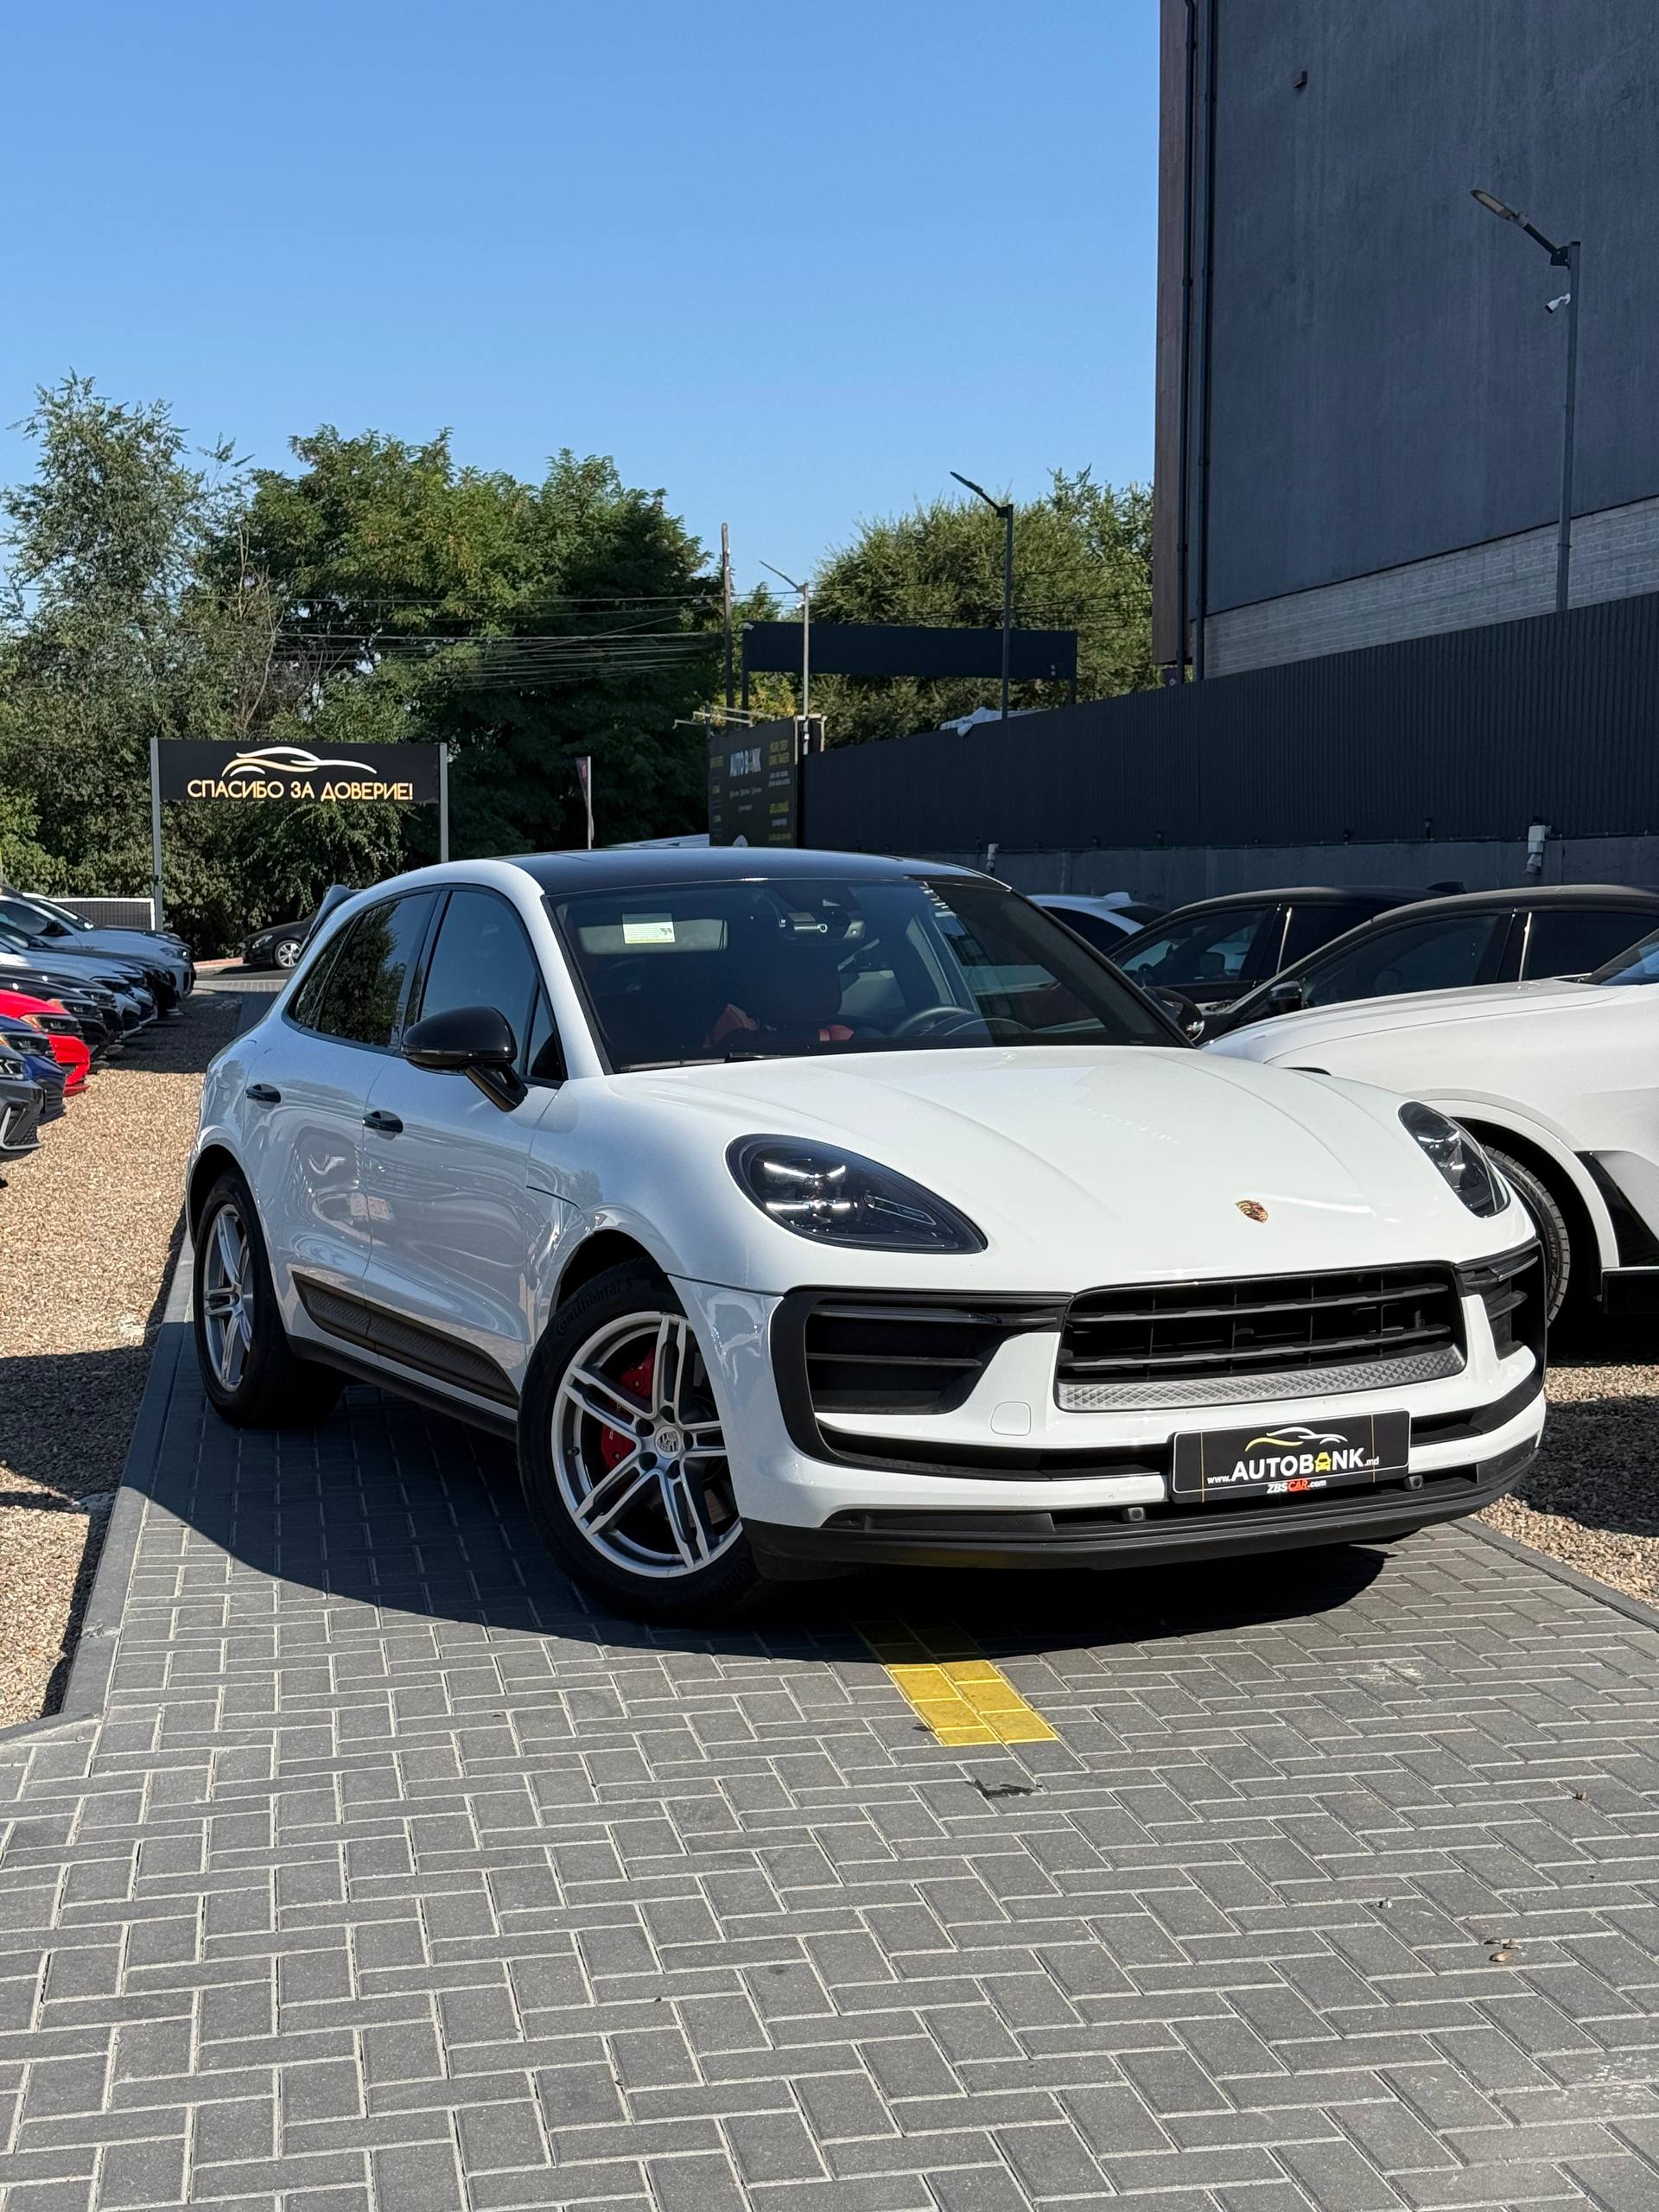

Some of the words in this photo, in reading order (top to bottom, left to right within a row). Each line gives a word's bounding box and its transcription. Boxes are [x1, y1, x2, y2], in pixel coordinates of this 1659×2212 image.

[187, 780, 285, 799] СПАСИБО
[290, 781, 315, 799] ЗА
[321, 782, 413, 802] ДОВЕРИЕ!
